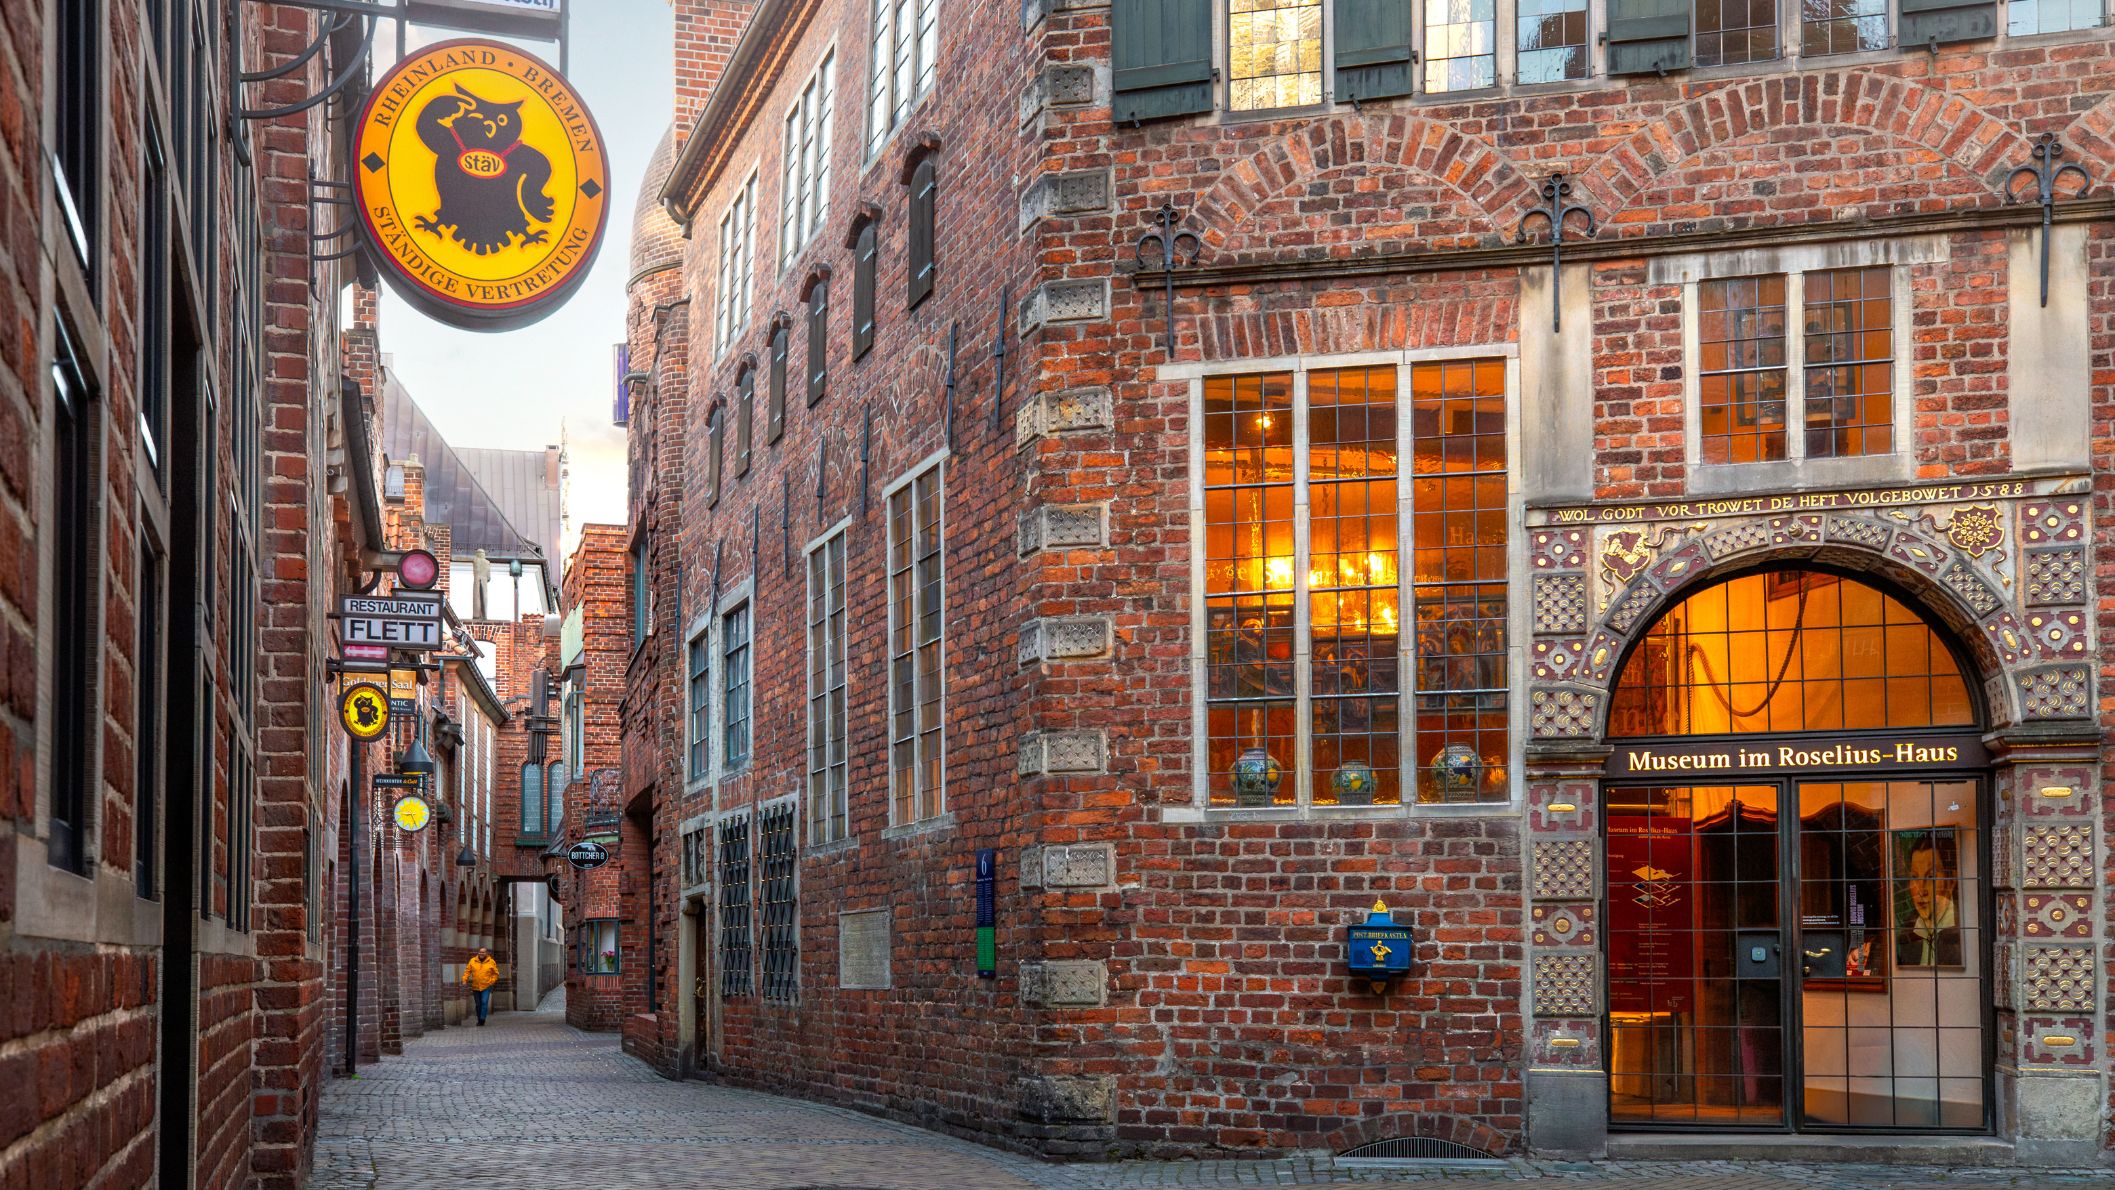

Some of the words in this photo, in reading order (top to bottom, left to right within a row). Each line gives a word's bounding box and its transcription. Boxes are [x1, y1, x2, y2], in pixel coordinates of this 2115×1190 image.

[374, 49, 497, 129] RHEINLAND
[521, 65, 594, 154] BREMEN
[464, 154, 501, 173] stäv
[373, 204, 461, 295] STÄNDIGE
[465, 226, 590, 301] VERTRETUNG
[1558, 509, 1596, 523] WOL
[1656, 504, 1696, 518] VOR
[1696, 498, 1764, 515] TROWET
[1770, 496, 1795, 510] DE
[1799, 493, 1839, 508] HEFT
[1843, 485, 1962, 506] VOLGEBOWET
[350, 599, 434, 615] RESTAURANT
[350, 619, 434, 643] FLETT
[391, 679, 413, 690] Saal
[1628, 750, 1731, 771] Museum
[1738, 748, 1771, 768] im
[1778, 743, 1958, 767] Roselius-Haus
[981, 853, 987, 876] 6
